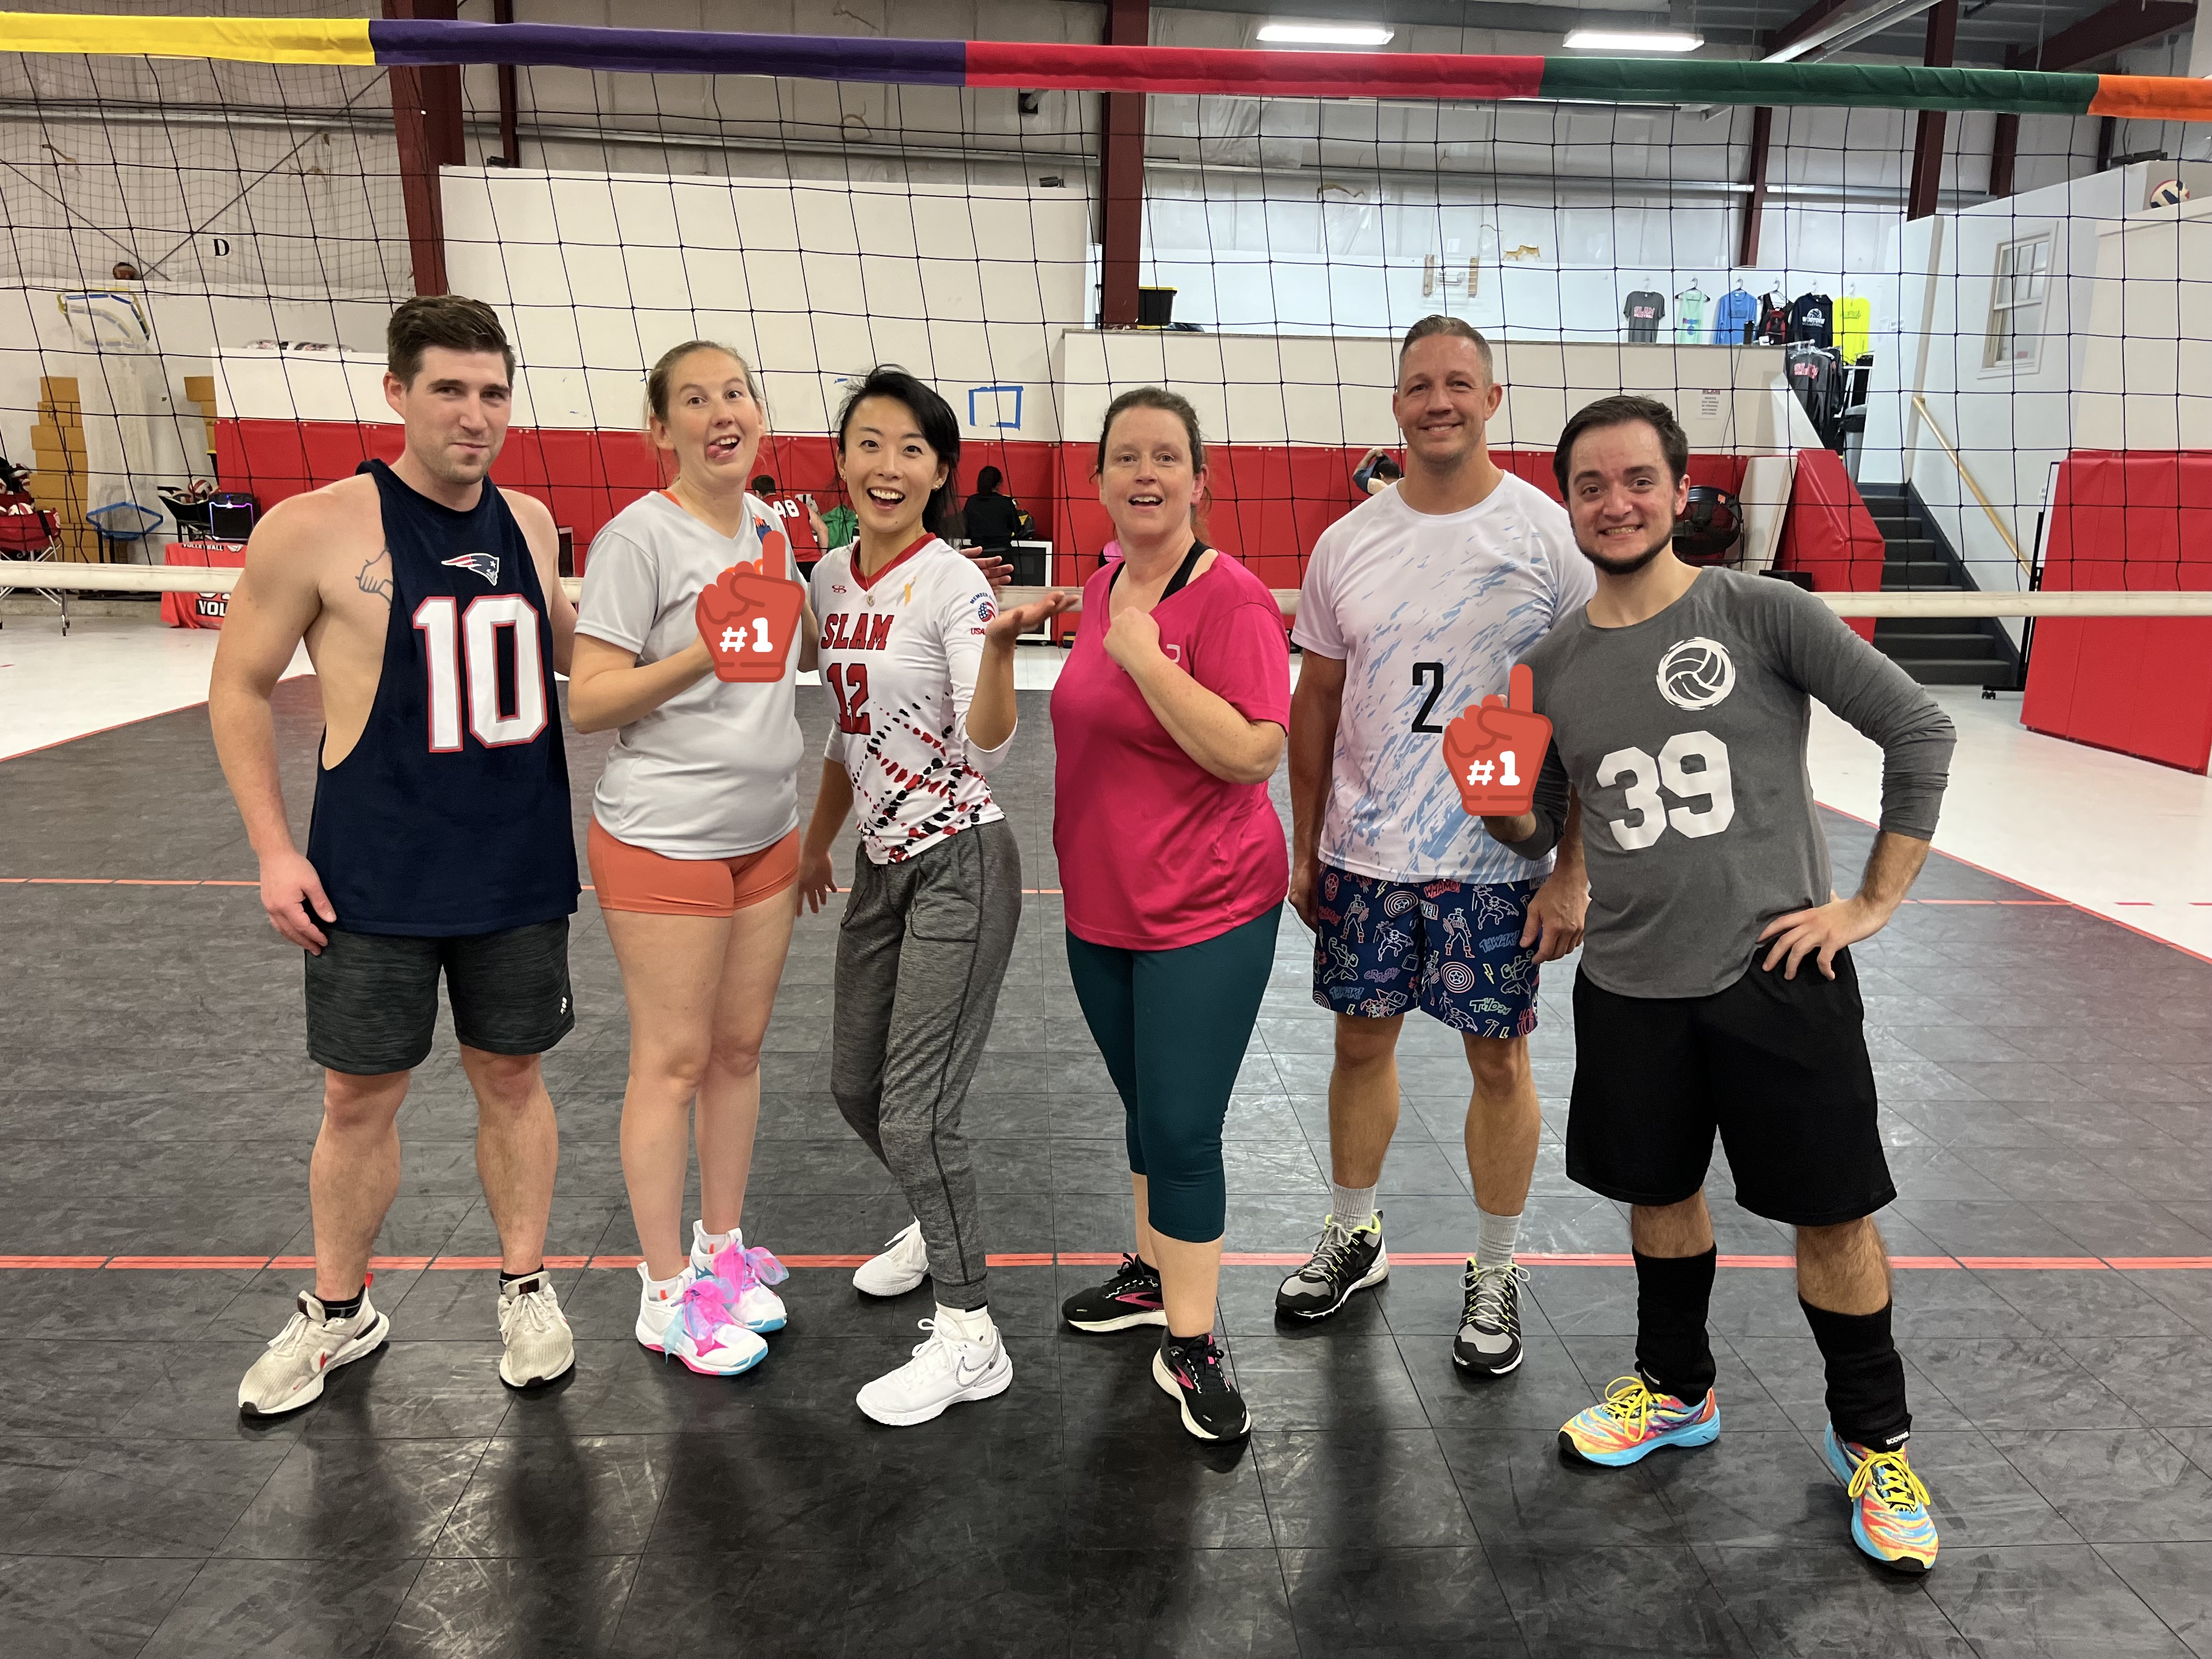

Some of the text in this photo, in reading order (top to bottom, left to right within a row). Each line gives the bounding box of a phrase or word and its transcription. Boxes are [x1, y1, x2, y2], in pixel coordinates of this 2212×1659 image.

[212, 239, 229, 256] D
[970, 592, 988, 604] MEMBER
[821, 613, 894, 650] SLAM
[413, 594, 548, 753] 10
[827, 663, 871, 735] 12
[1412, 662, 1443, 733] 2
[1596, 730, 1735, 850] 39
[1424, 878, 1461, 899] WHAMO!
